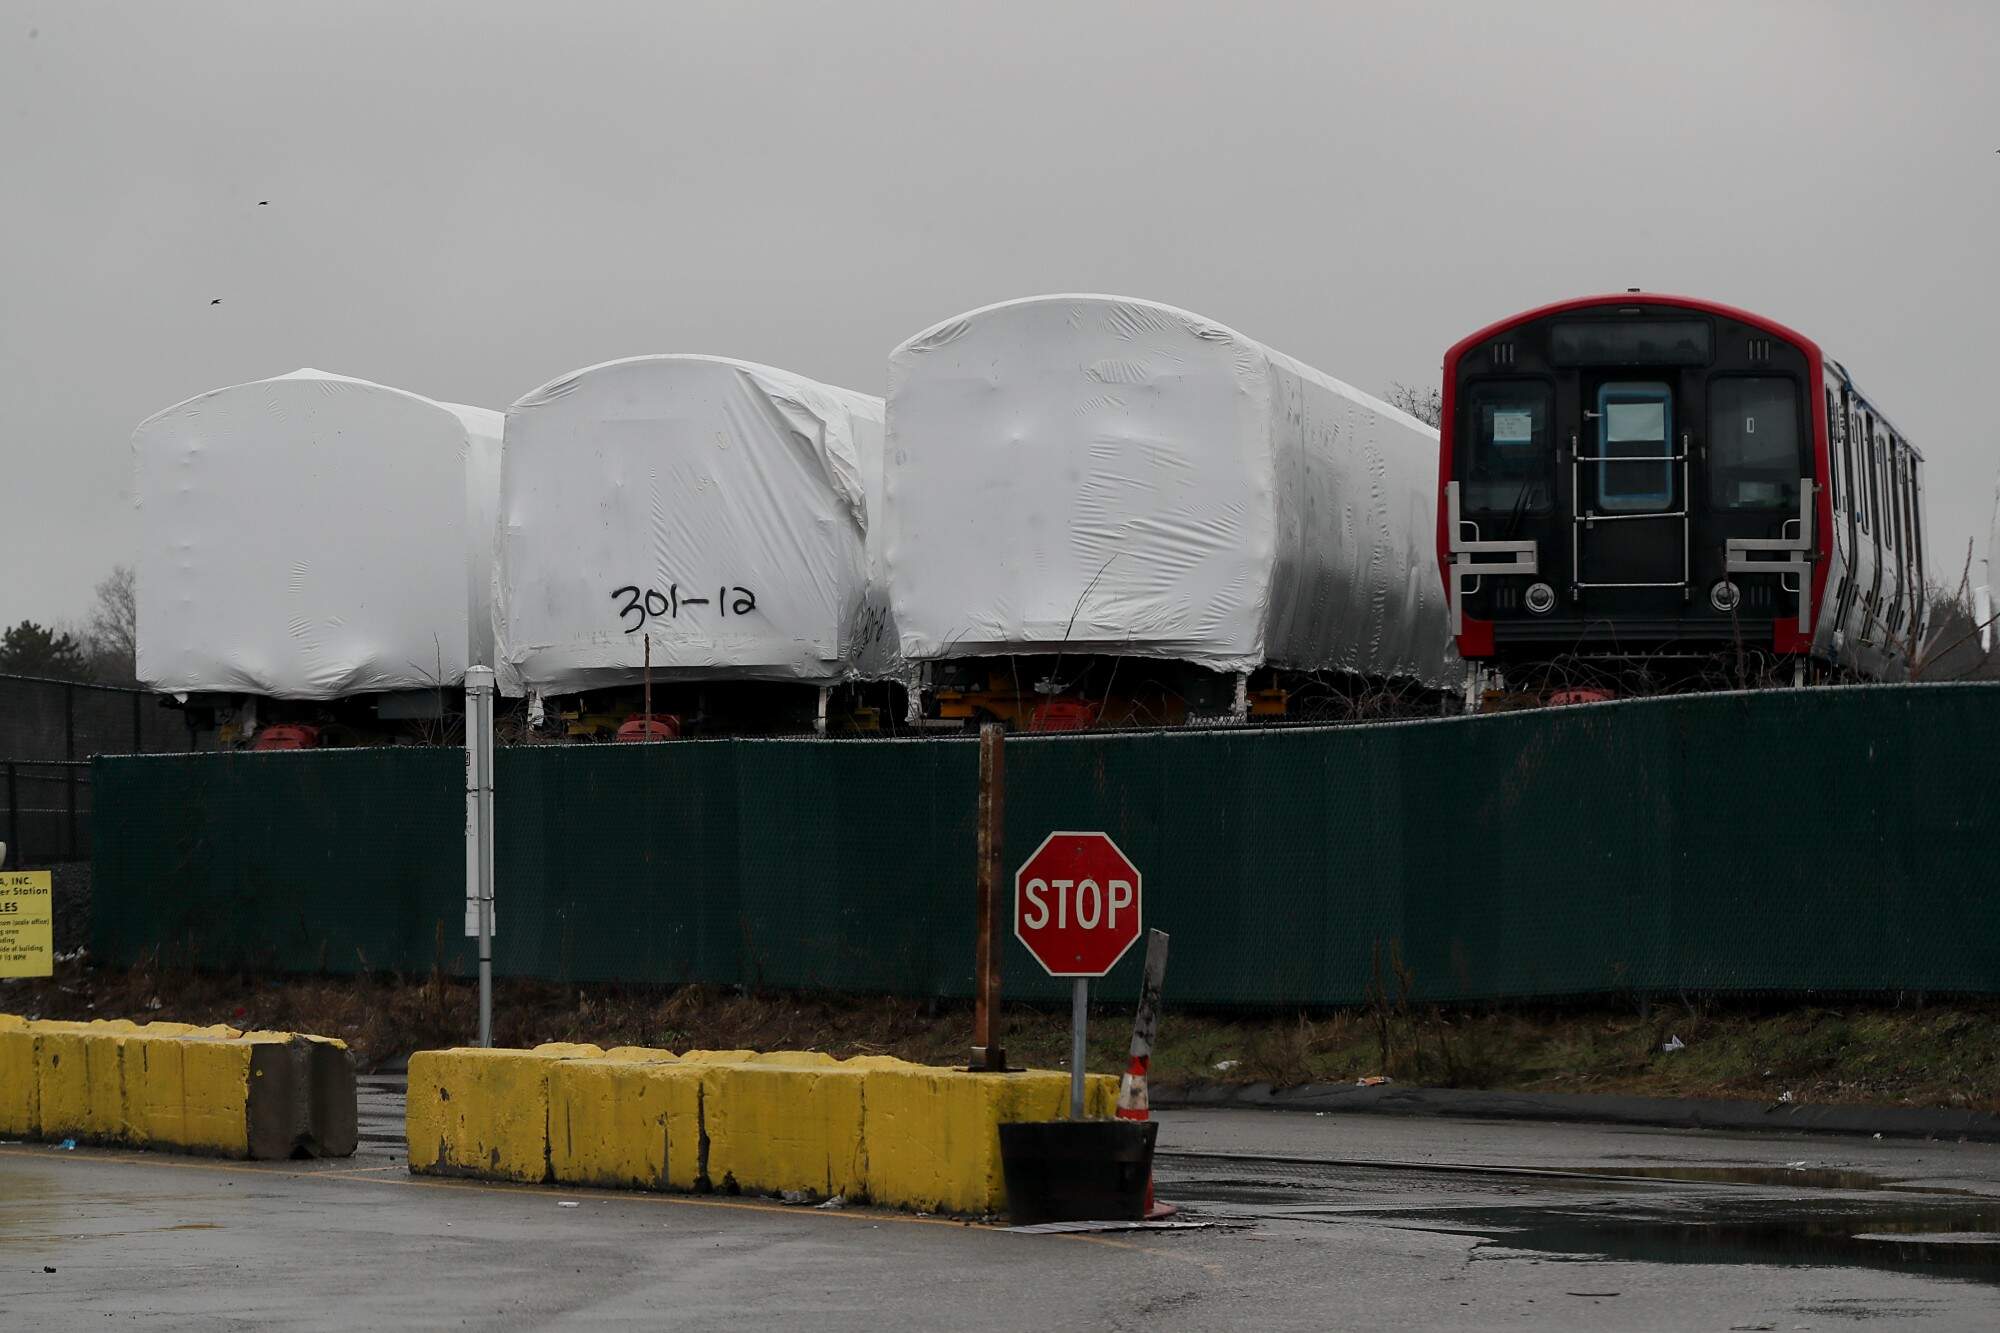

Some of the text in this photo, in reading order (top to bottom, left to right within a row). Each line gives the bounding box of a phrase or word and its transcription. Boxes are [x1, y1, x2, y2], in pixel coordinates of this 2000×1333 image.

[610, 583, 756, 634] 301-12
[12, 877, 32, 885] INC.
[13, 887, 48, 895] Station
[1024, 878, 1133, 930] STOP
[19, 944, 43, 952] building
